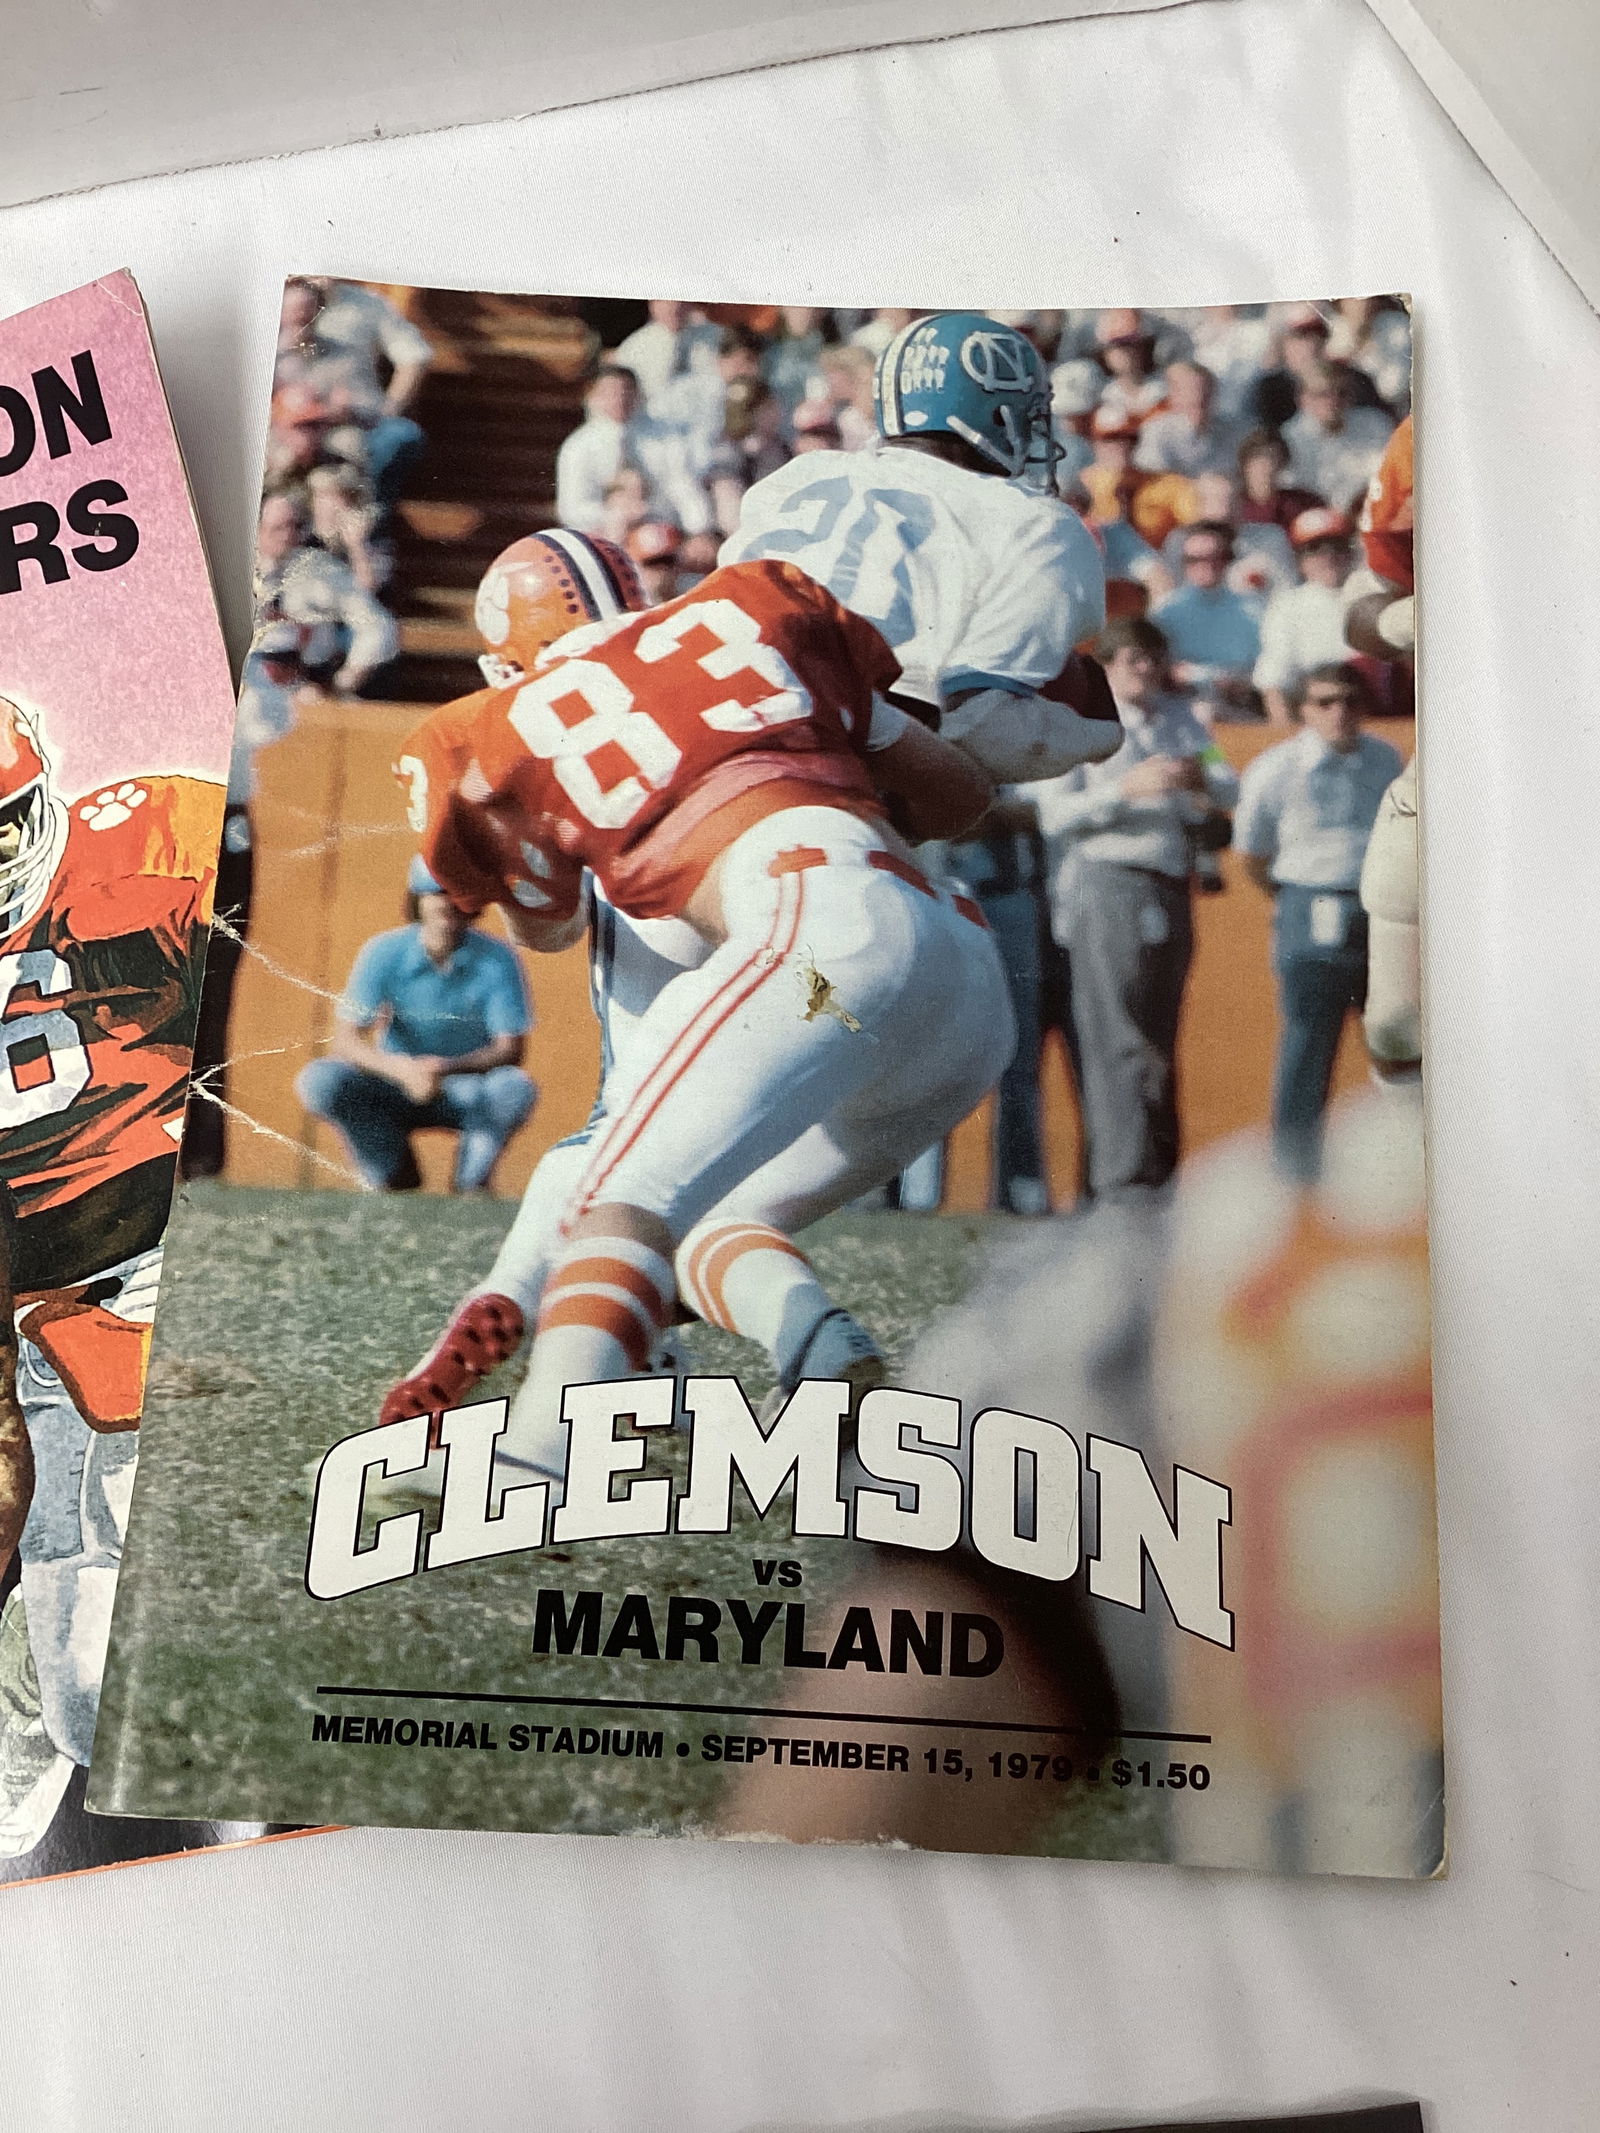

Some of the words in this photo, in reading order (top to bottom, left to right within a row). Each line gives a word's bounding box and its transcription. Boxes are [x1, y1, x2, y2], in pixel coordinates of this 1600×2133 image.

[0, 479, 140, 595] RS
[507, 598, 813, 829] 83
[304, 1375, 1236, 1653] CLEMSON
[532, 1588, 1005, 1679] MARYLAND
[311, 1714, 497, 1751] MEMORIAL
[508, 1724, 664, 1759] STADIUM
[701, 1735, 910, 1772] SEPTEMBER
[923, 1748, 974, 1782] 15,
[987, 1754, 1073, 1782] 1979
[1111, 1758, 1211, 1791] $1.50
